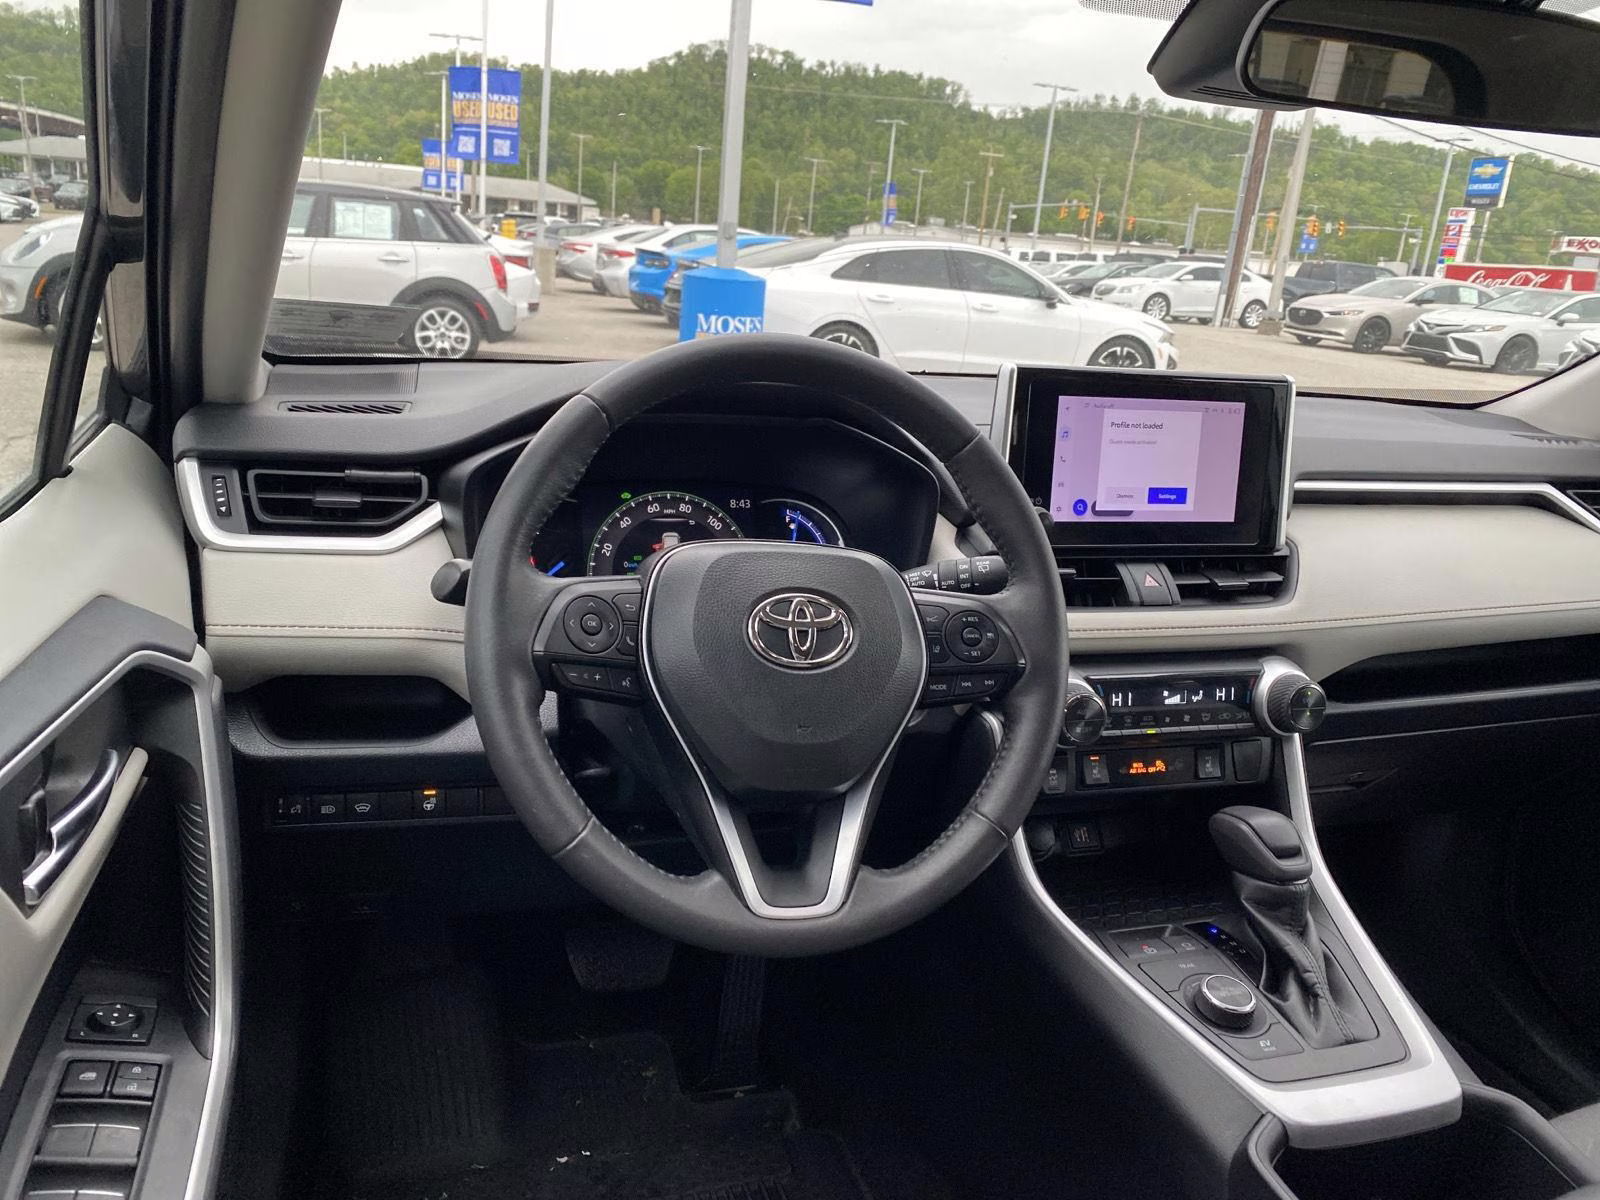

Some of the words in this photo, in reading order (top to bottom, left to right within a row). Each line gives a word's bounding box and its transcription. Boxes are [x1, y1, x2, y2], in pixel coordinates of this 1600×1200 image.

[488, 102, 518, 121] USED
[1567, 238, 1600, 251] EXXO
[696, 313, 764, 334] MOSES
[1110, 421, 1131, 429] Profile
[1143, 422, 1164, 430] loaded
[647, 503, 660, 513] 60
[679, 503, 692, 513] 80
[729, 499, 751, 509] 8:43
[620, 516, 632, 529] 40
[706, 515, 723, 531] 100
[785, 515, 791, 523] F
[601, 543, 613, 557] 20
[1259, 1039, 1271, 1047] EV
